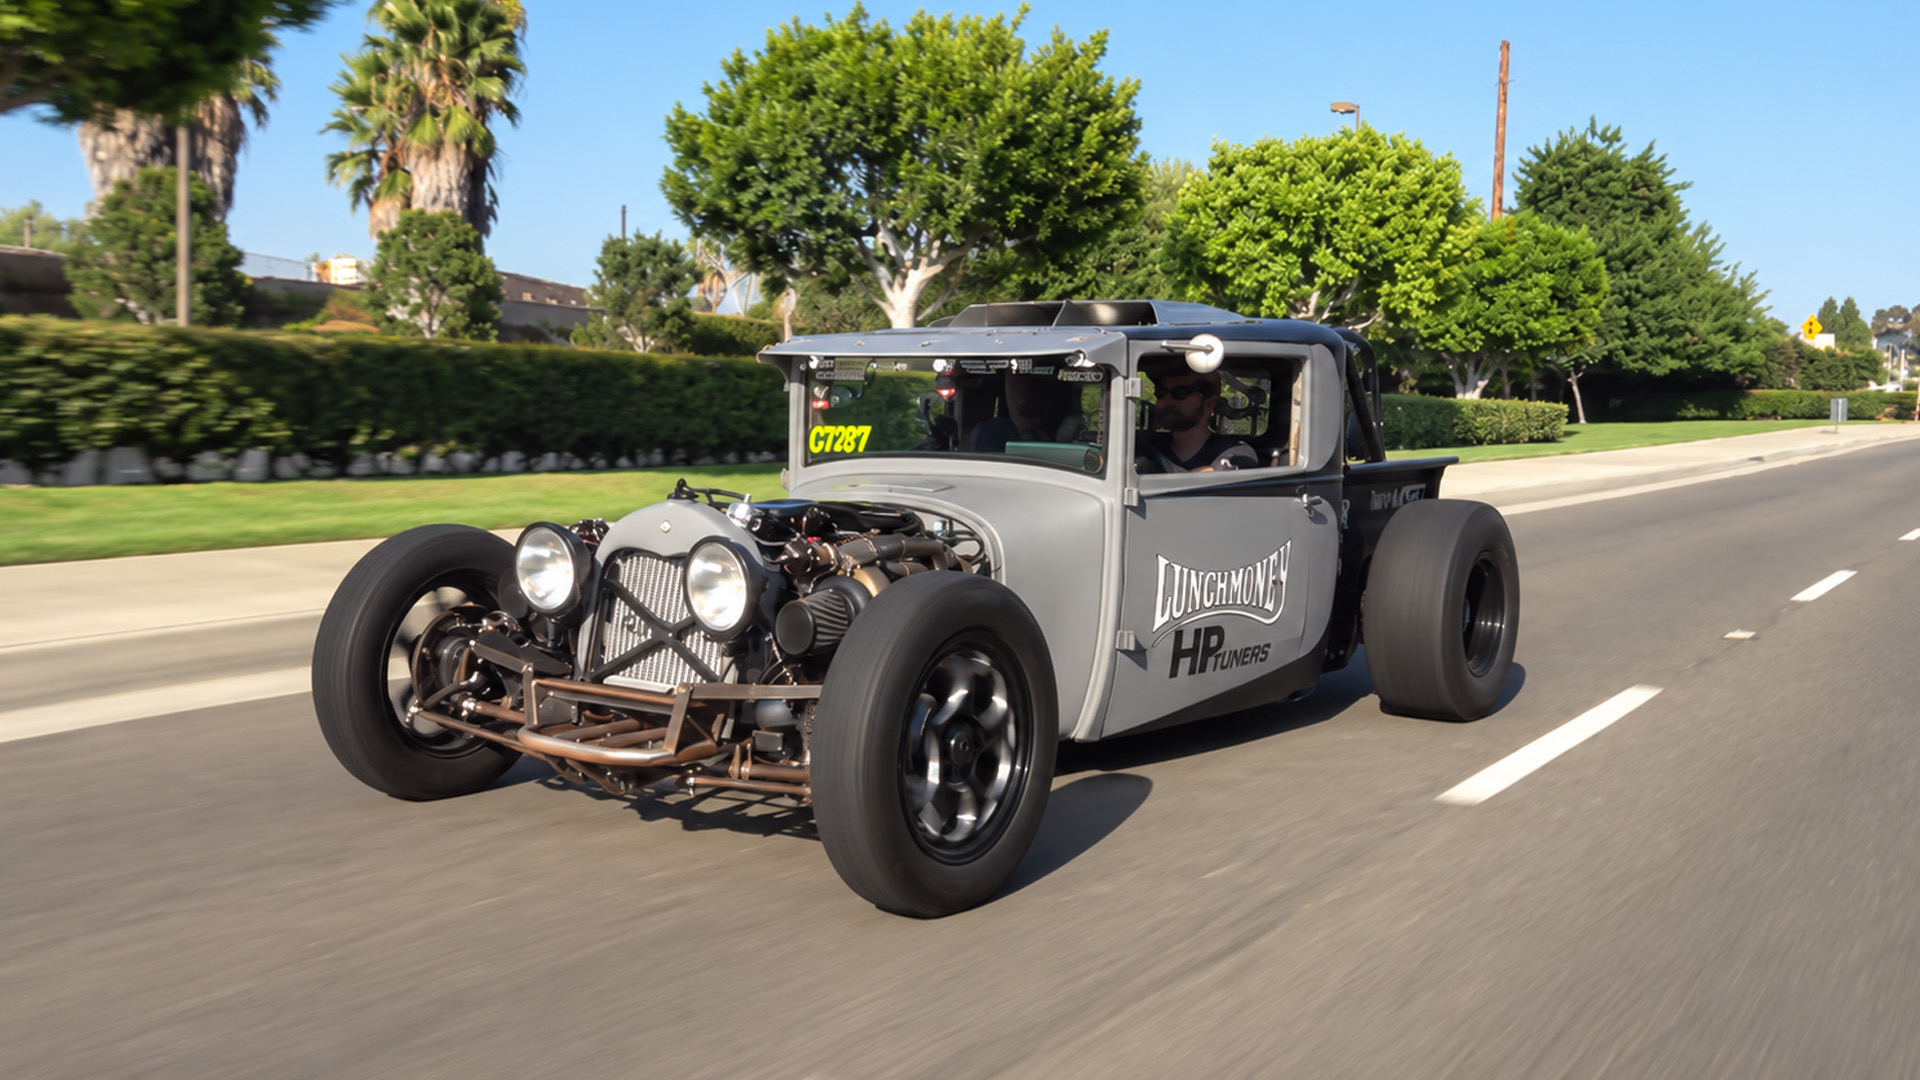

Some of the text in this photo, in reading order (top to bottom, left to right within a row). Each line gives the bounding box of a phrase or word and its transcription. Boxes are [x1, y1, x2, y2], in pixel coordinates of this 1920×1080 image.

[809, 425, 872, 454] C7287
[1152, 538, 1292, 638] LUNCHMONEY
[1168, 625, 1271, 679] HP TUNERS
